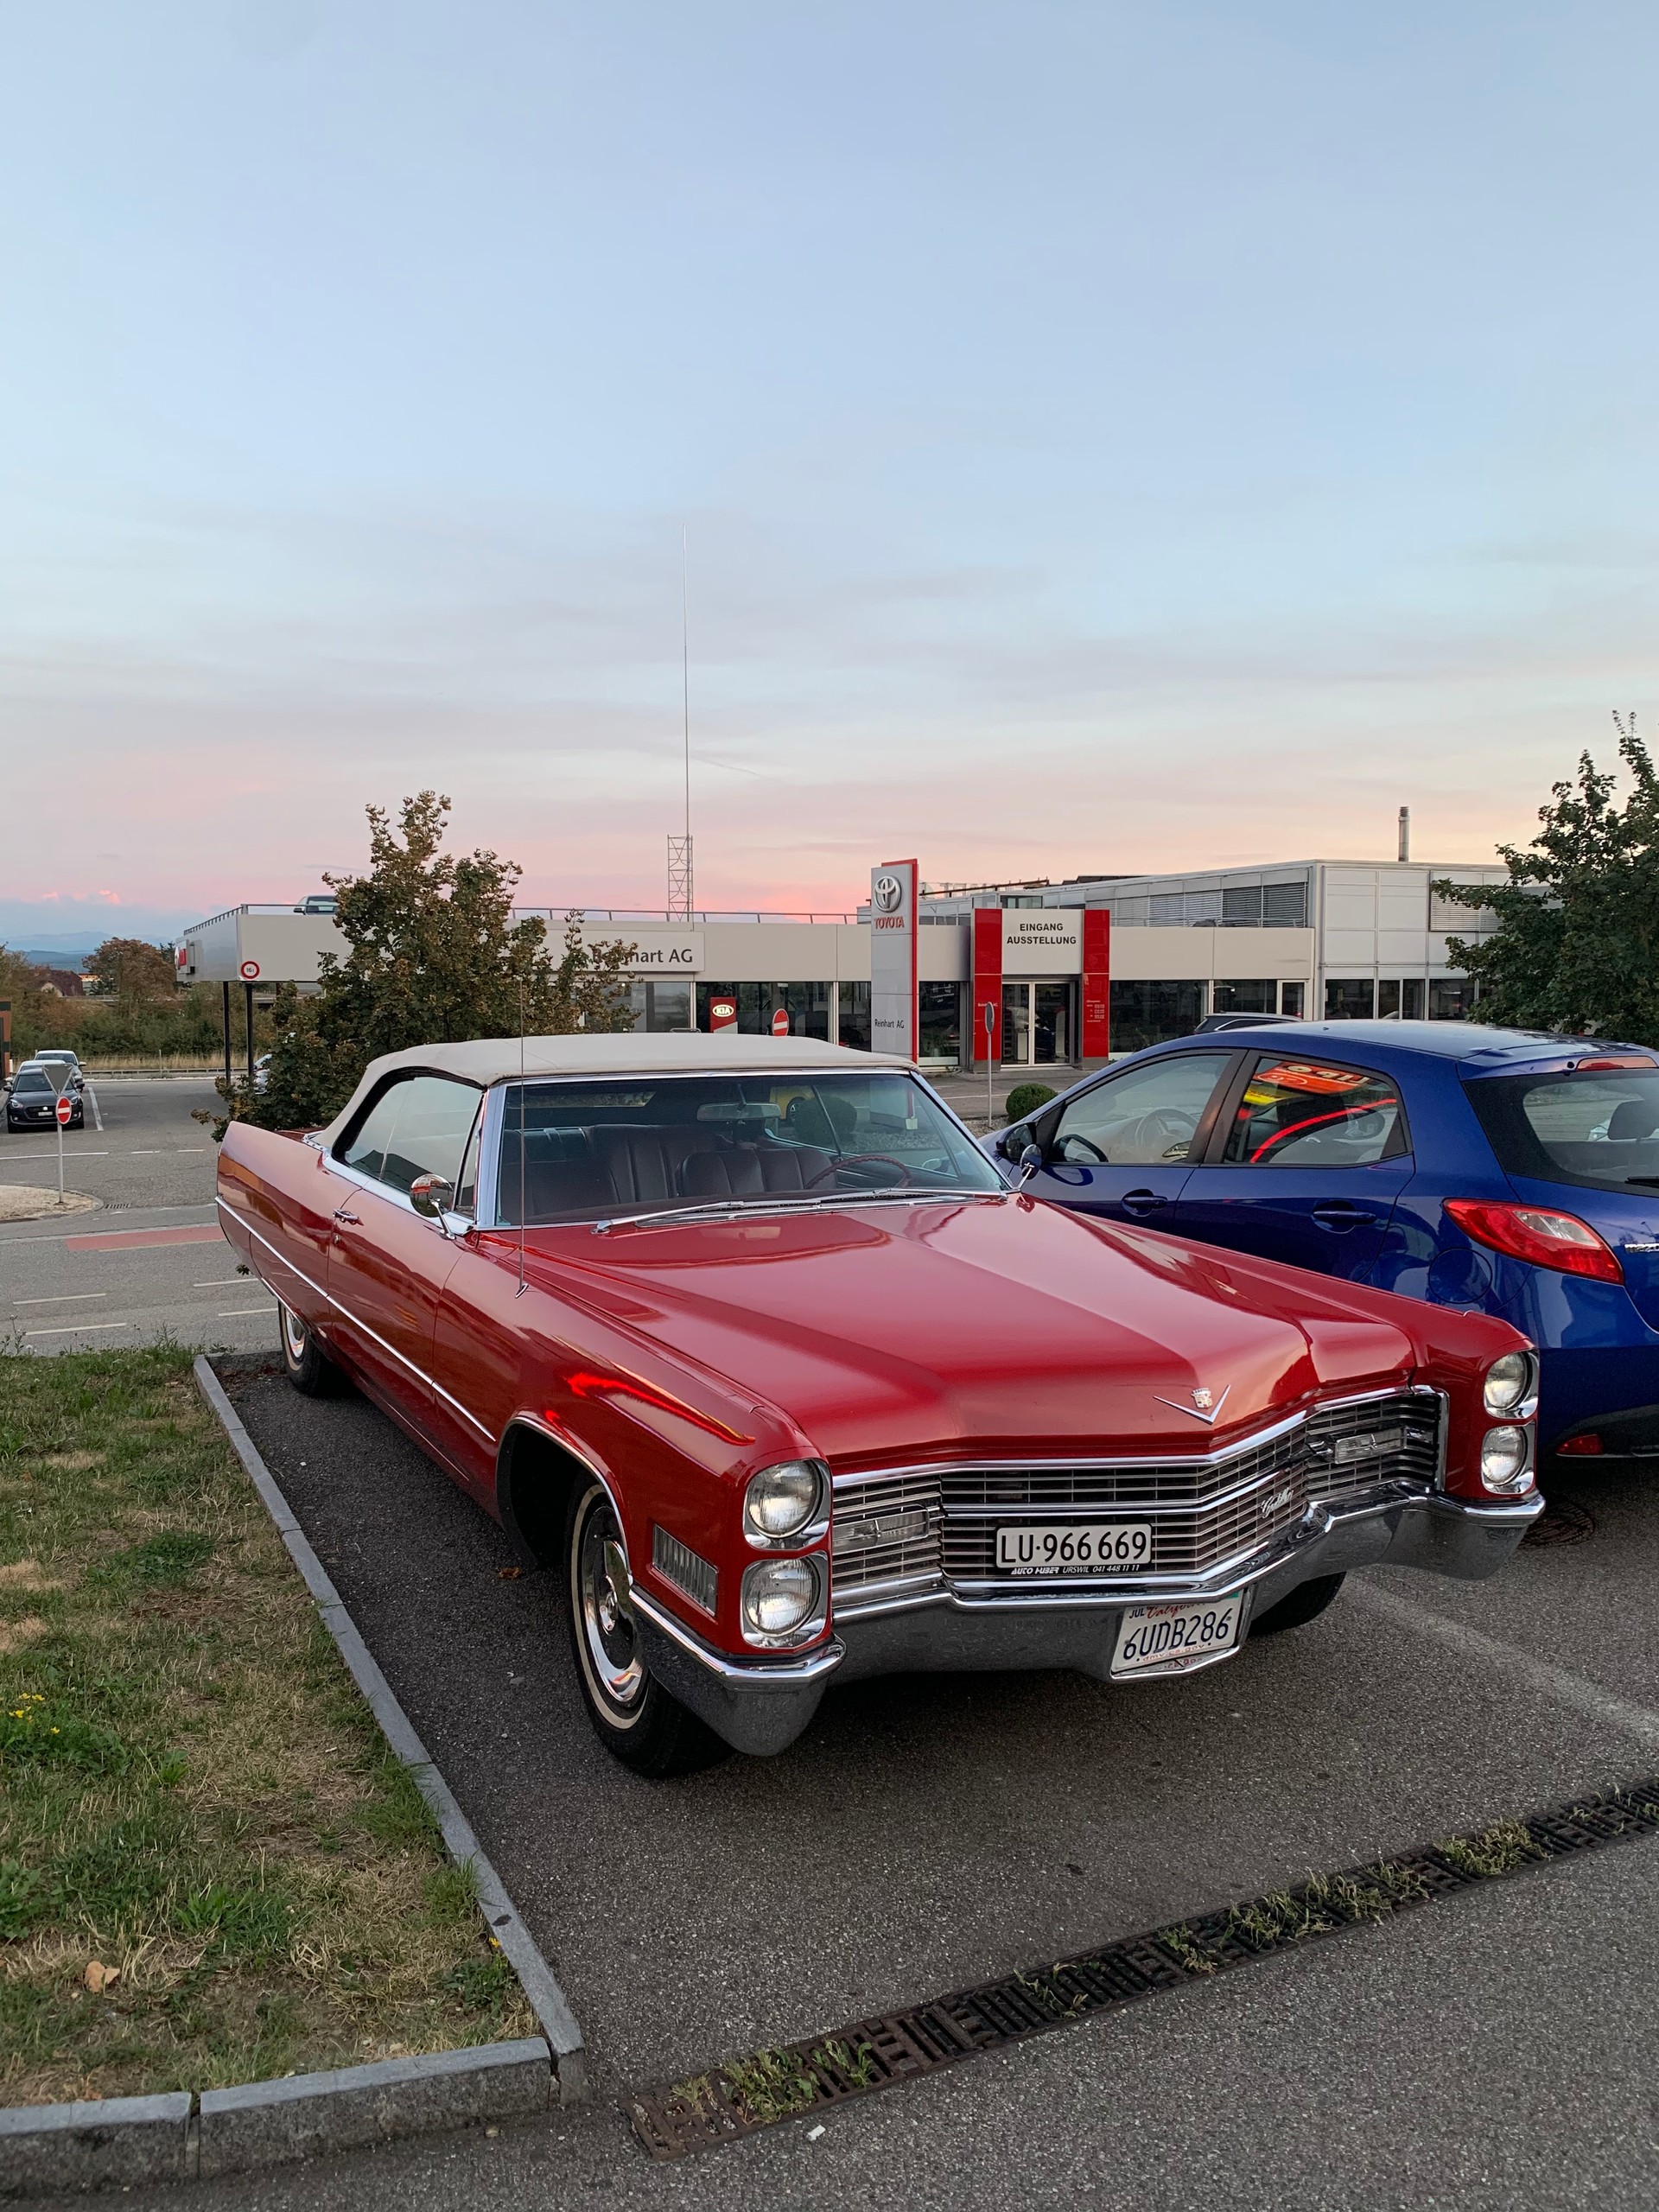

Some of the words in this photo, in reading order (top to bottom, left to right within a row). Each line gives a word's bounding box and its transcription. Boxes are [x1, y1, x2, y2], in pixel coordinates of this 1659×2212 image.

[874, 916, 905, 929] TOYOTA
[1020, 923, 1064, 931] EINGANG
[1007, 936, 1077, 944] AUSSTELLUNG
[669, 949, 693, 963] AG
[874, 1019, 894, 1028] Reinhart
[896, 1020, 905, 1028] AG
[1062, 1565, 1090, 1573] URSWIL
[1129, 1608, 1145, 1619] JUL
[1122, 1607, 1234, 1661] 6UDB286
